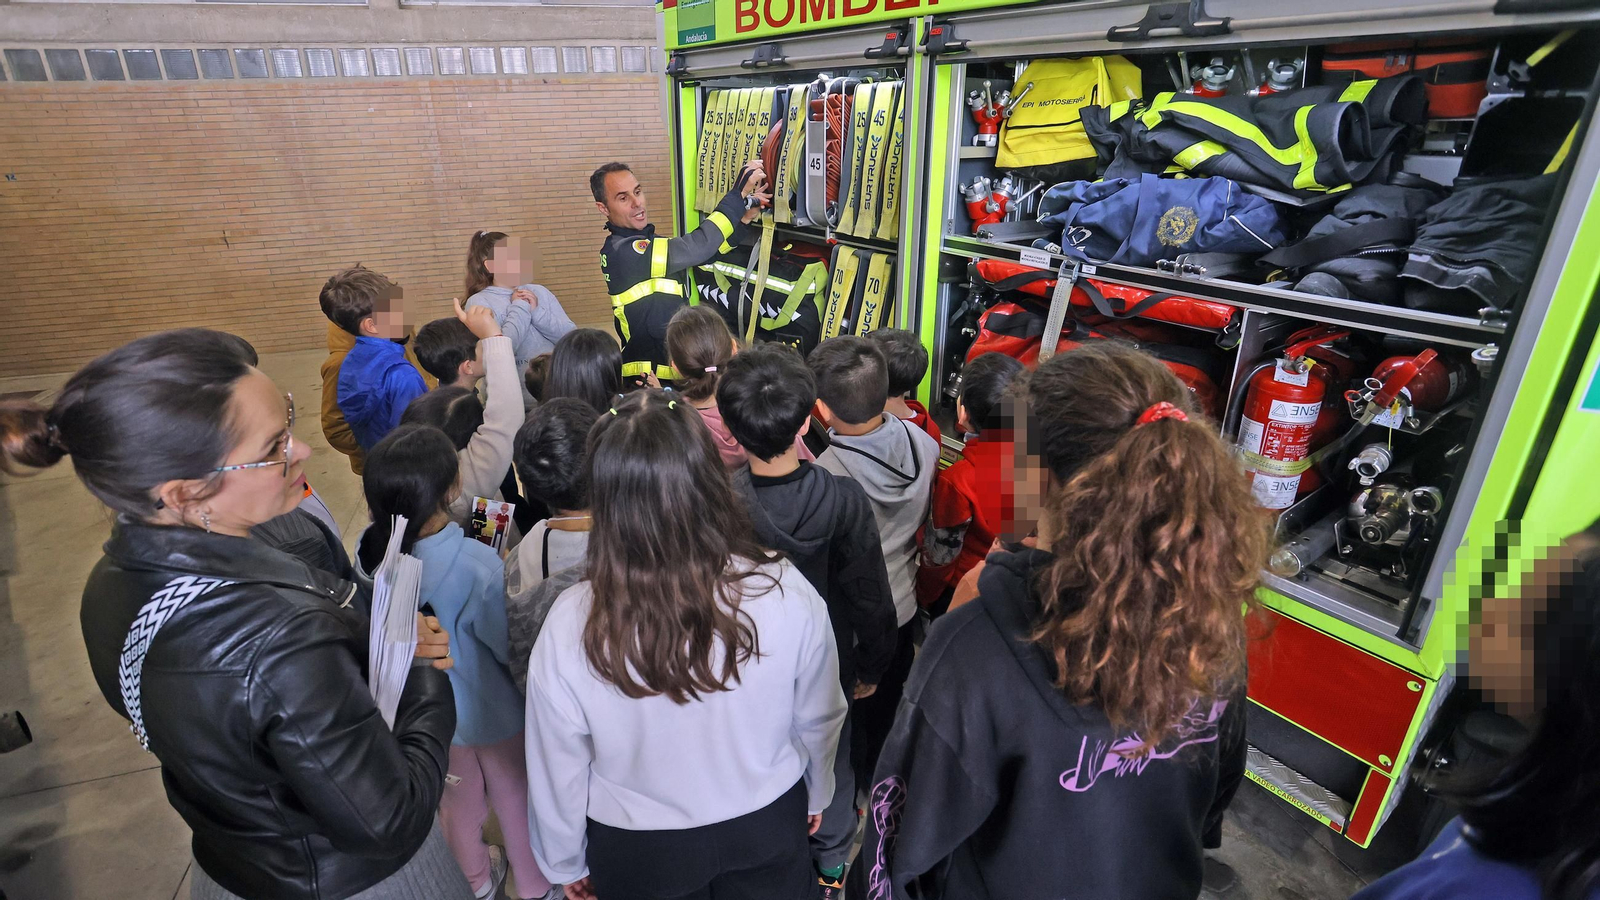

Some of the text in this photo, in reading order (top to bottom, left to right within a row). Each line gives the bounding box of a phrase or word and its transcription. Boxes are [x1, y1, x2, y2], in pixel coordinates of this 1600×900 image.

[735, 0, 939, 33] BOM
[706, 110, 714, 124] 25
[716, 112, 724, 125] 25
[727, 112, 734, 126] 25
[747, 113, 756, 127] 25
[759, 112, 769, 127] 25
[857, 111, 866, 128] 25
[874, 109, 886, 126] 45
[810, 158, 821, 170] 45
[835, 268, 844, 285] 70
[868, 277, 880, 294] 70
[1252, 772, 1276, 792] VADEO
[1276, 789, 1323, 820] CARROZADO
